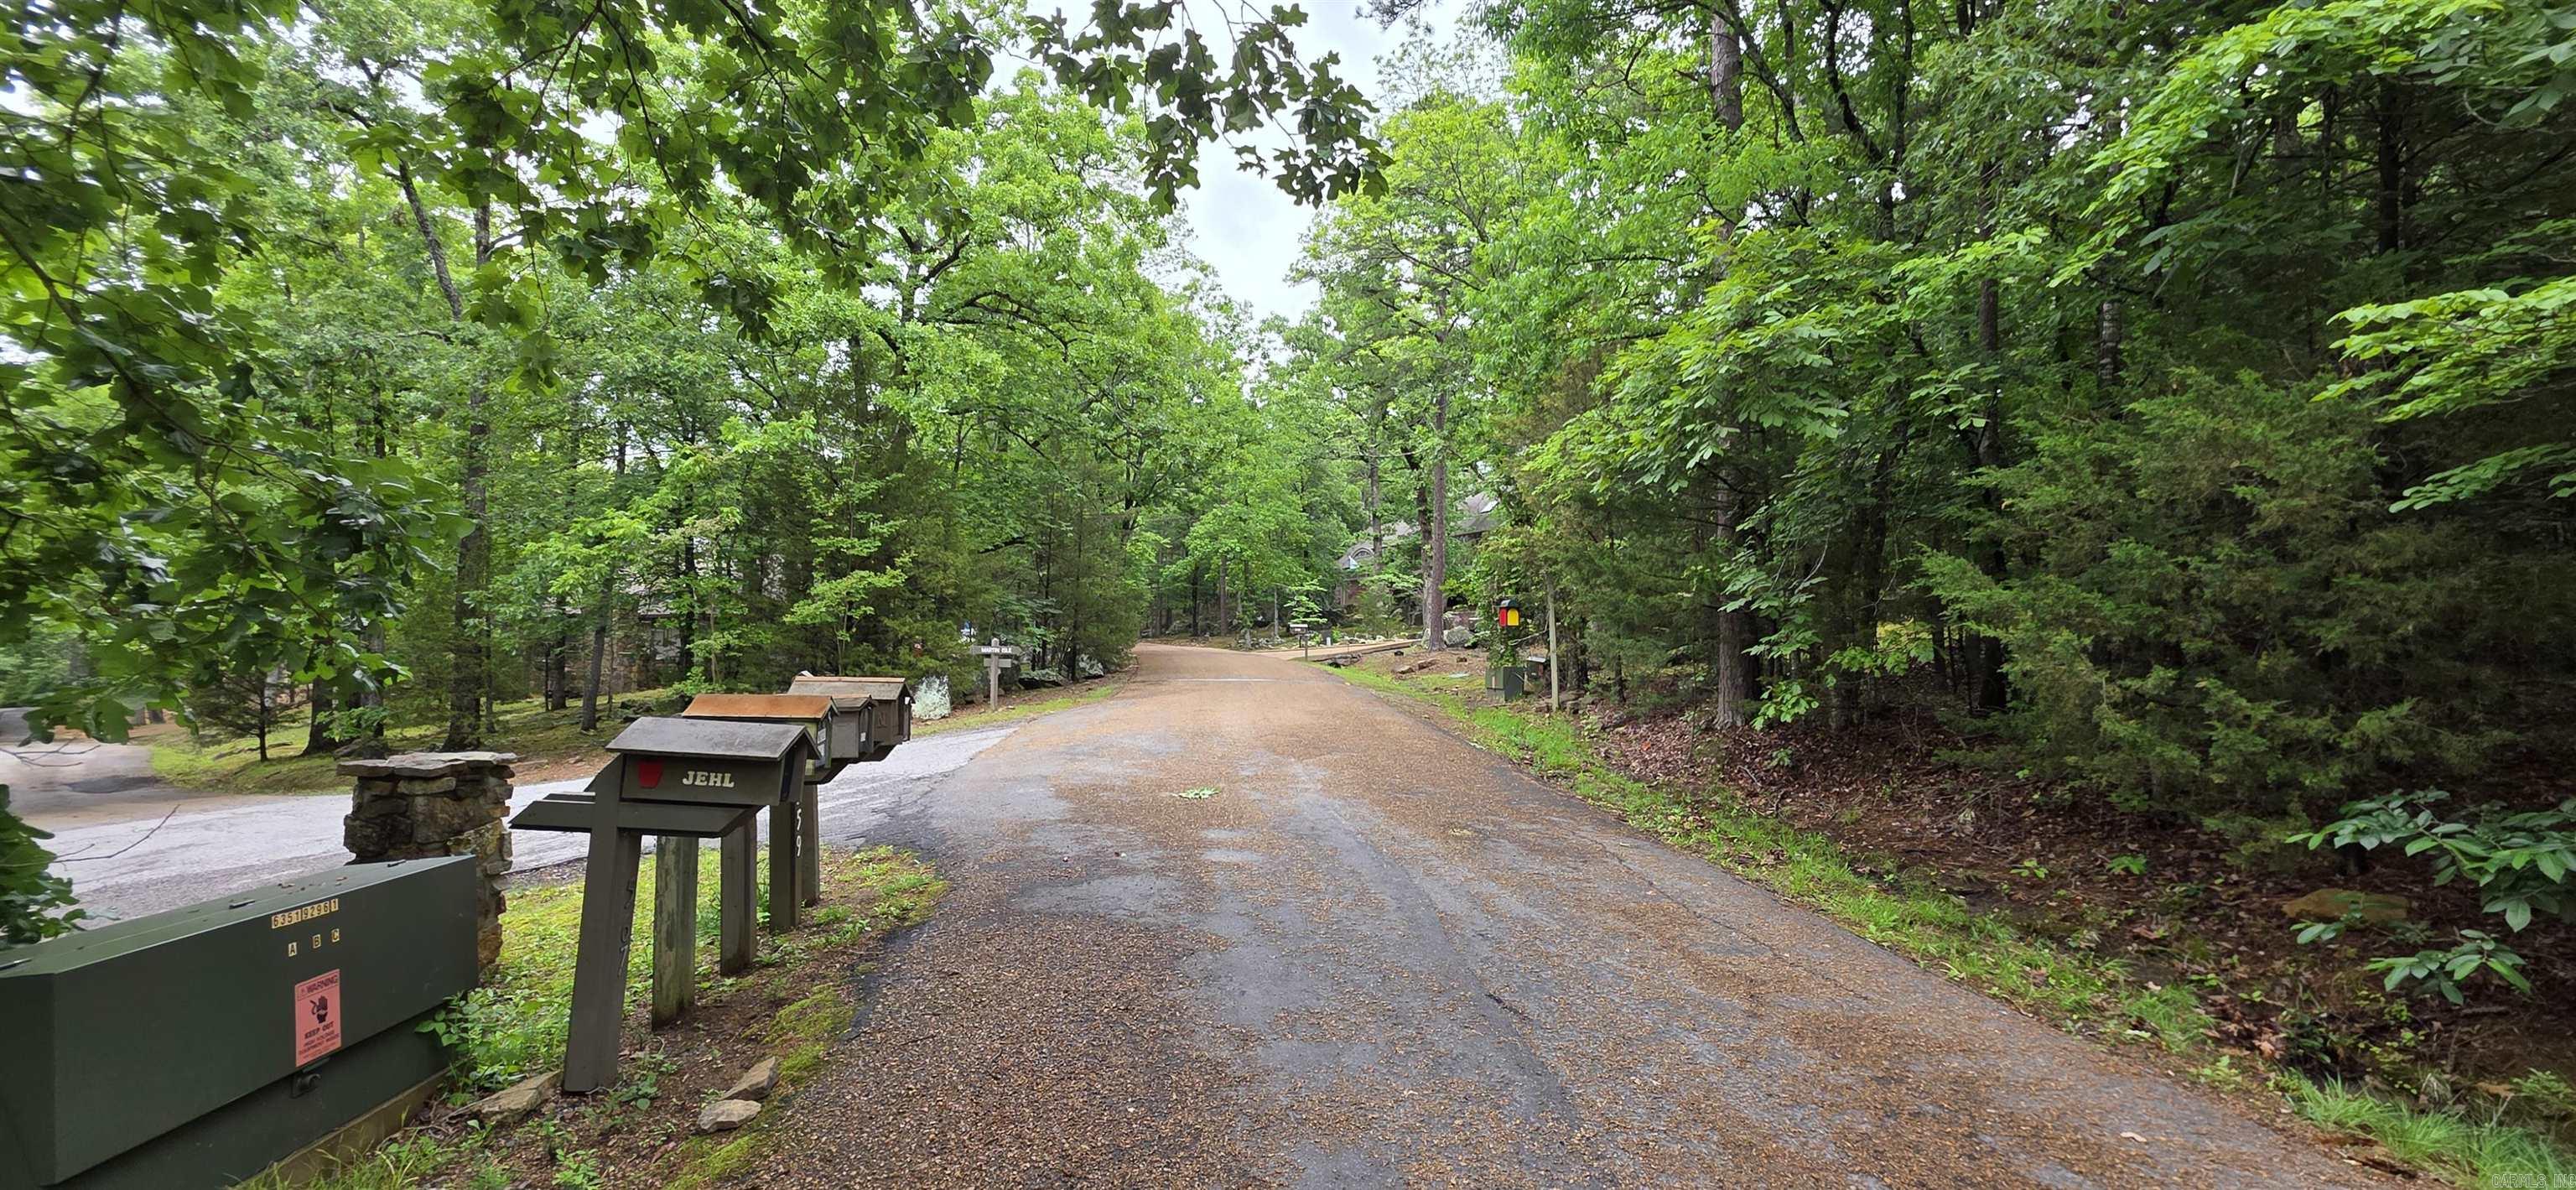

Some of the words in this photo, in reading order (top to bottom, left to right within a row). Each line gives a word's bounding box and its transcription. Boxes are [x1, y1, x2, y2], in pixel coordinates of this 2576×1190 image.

[682, 771, 735, 787] JEHL
[289, 943, 296, 955] A
[314, 936, 320, 948] B
[332, 929, 339, 941] C
[307, 974, 338, 993] WARNING
[304, 1026, 320, 1039] KEEP
[322, 1021, 335, 1032] OUT
